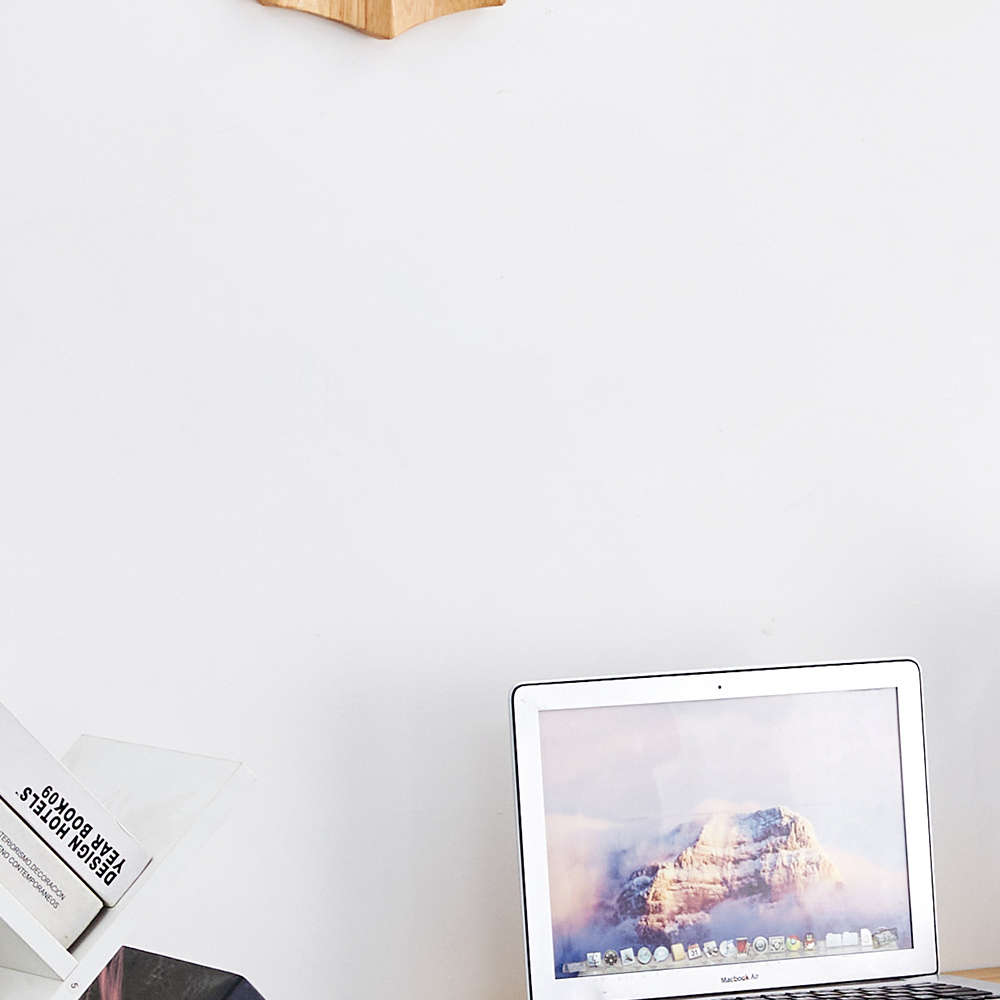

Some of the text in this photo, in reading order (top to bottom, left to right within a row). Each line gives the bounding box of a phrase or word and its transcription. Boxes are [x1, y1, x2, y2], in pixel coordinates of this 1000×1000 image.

[67, 835, 118, 887] DESIGN
[91, 834, 126, 875] YEAR
[8, 856, 60, 909] CONTEMPORANEOS
[721, 974, 749, 983] Macbook
